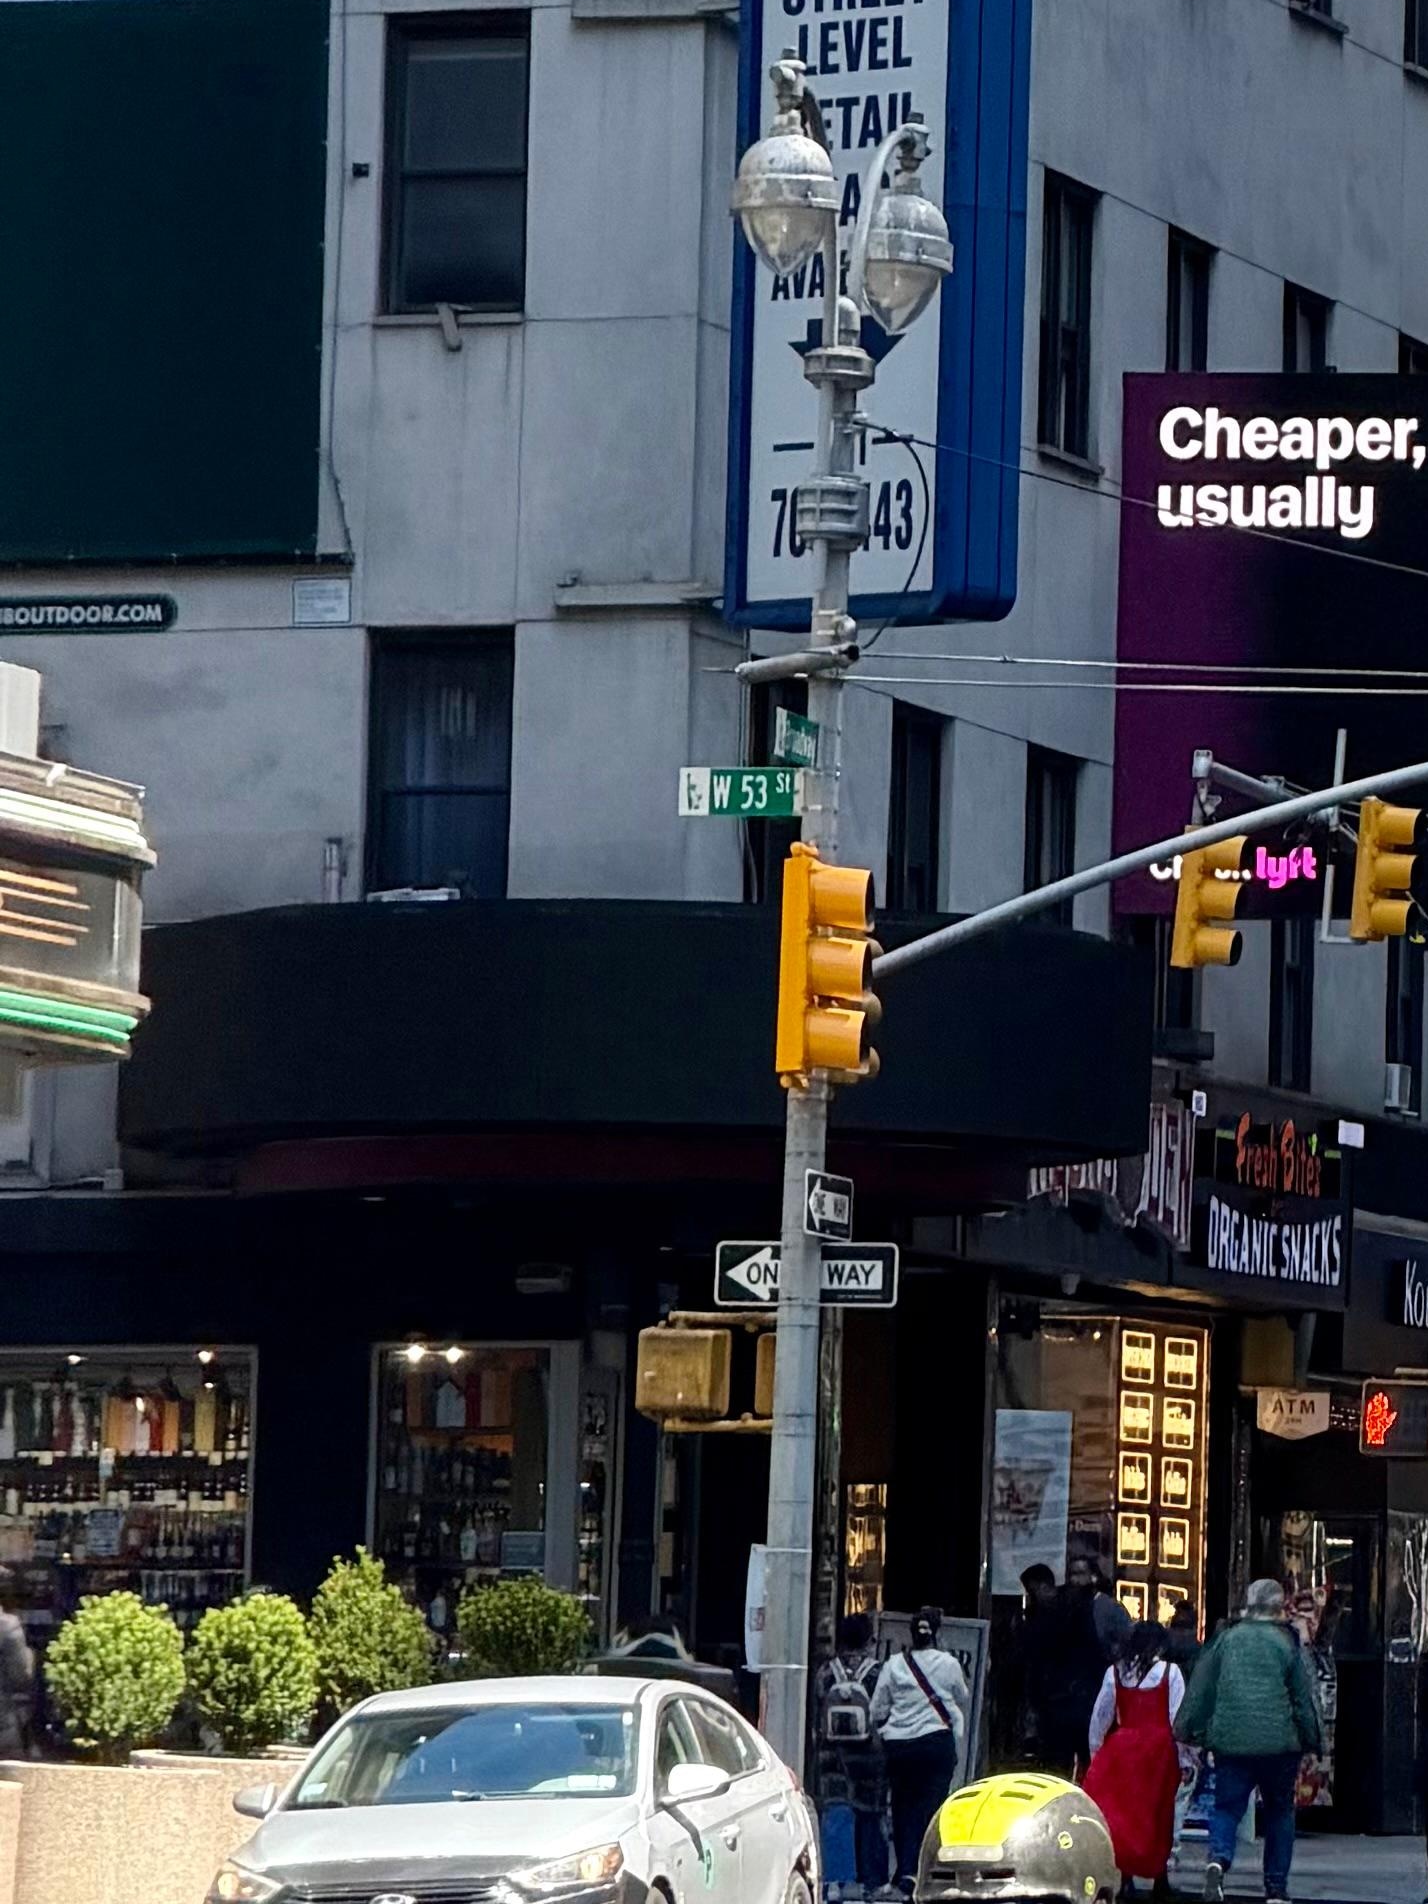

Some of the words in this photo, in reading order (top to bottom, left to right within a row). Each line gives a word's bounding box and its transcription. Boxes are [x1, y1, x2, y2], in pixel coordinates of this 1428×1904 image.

[798, 15, 914, 76] LEVEL
[1158, 406, 1428, 470] Cheaper,
[1156, 475, 1375, 538] usually
[713, 775, 731, 809] W
[741, 775, 767, 809] 53
[775, 772, 791, 794] St
[1256, 846, 1317, 888] lyft
[1235, 1111, 1277, 1188] Fresh
[1281, 1119, 1321, 1197] Bites
[1207, 1195, 1277, 1277] ORGANIC
[1281, 1215, 1341, 1286] SNACKS
[746, 1262, 779, 1285] ON
[827, 1263, 876, 1286] WAY
[1272, 1397, 1315, 1415] ATM
